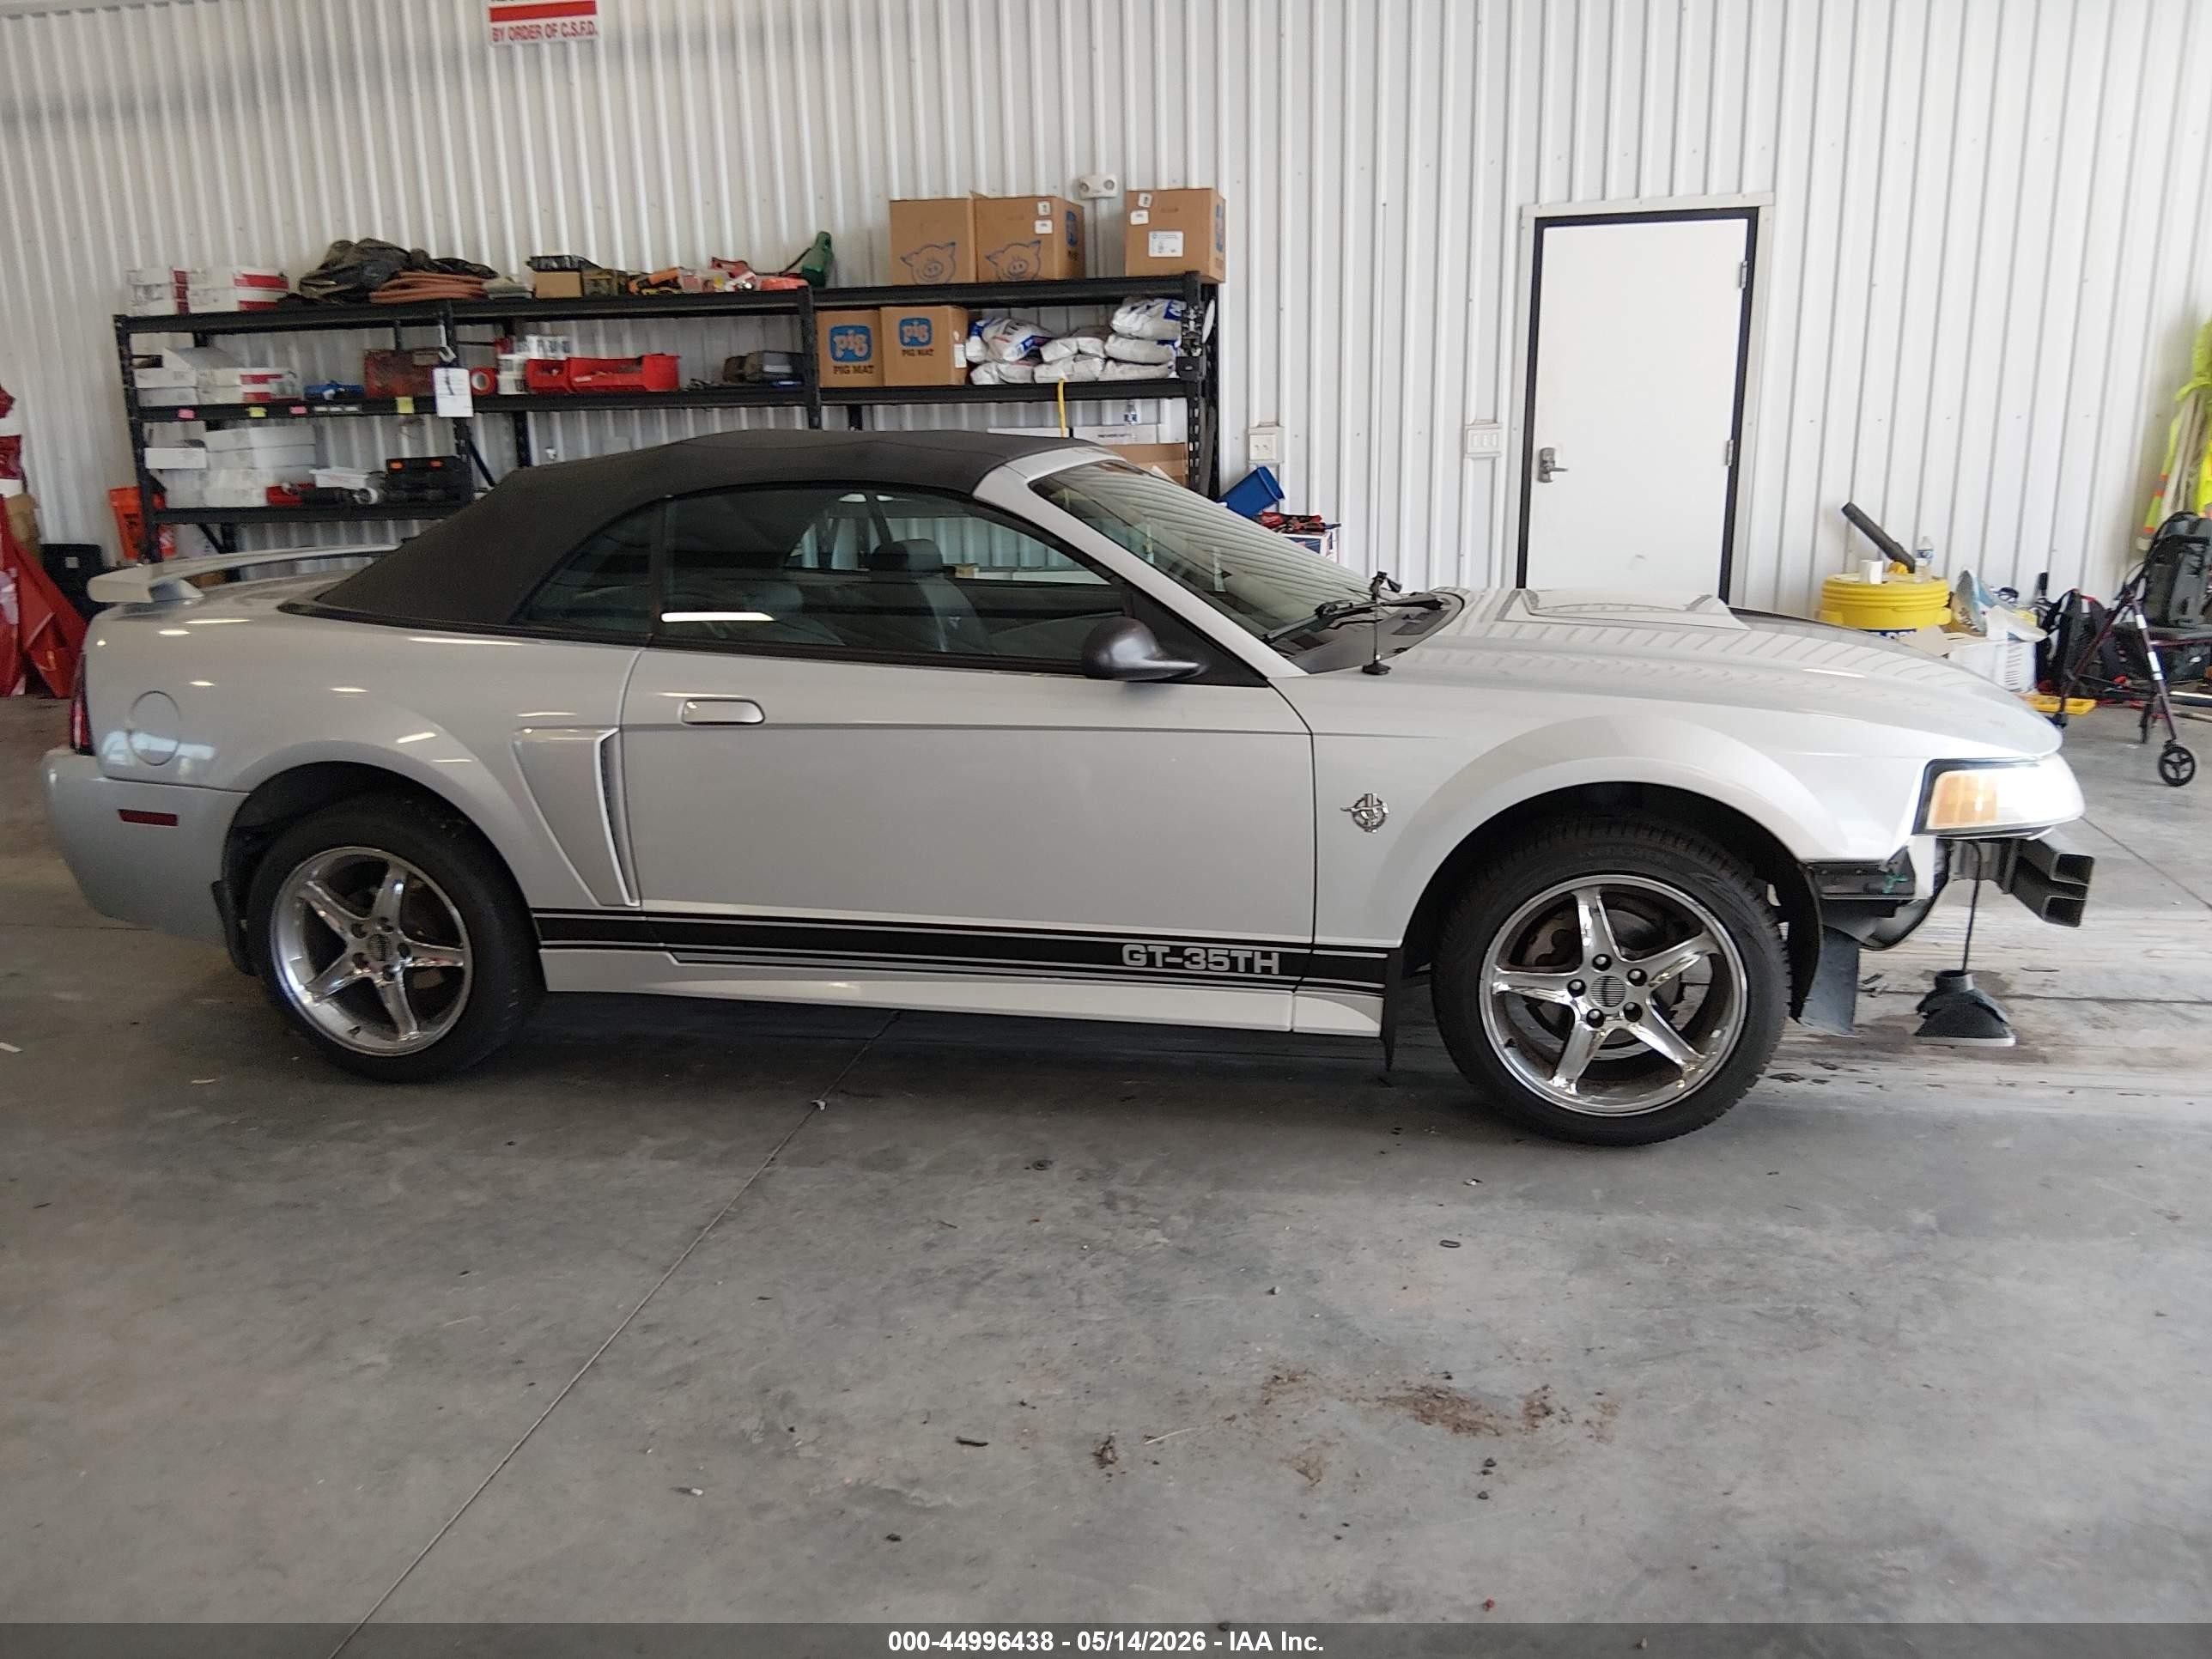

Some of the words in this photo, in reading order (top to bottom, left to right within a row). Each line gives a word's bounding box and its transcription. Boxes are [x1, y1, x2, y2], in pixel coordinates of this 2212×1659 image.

[492, 27, 505, 41] BY
[508, 24, 542, 40] ORDER
[545, 23, 558, 38] OF
[902, 319, 929, 343] pig
[833, 329, 869, 358] pig
[833, 365, 851, 374] PIG
[853, 365, 874, 374] MAT
[1121, 944, 1280, 975] GT-35TH
